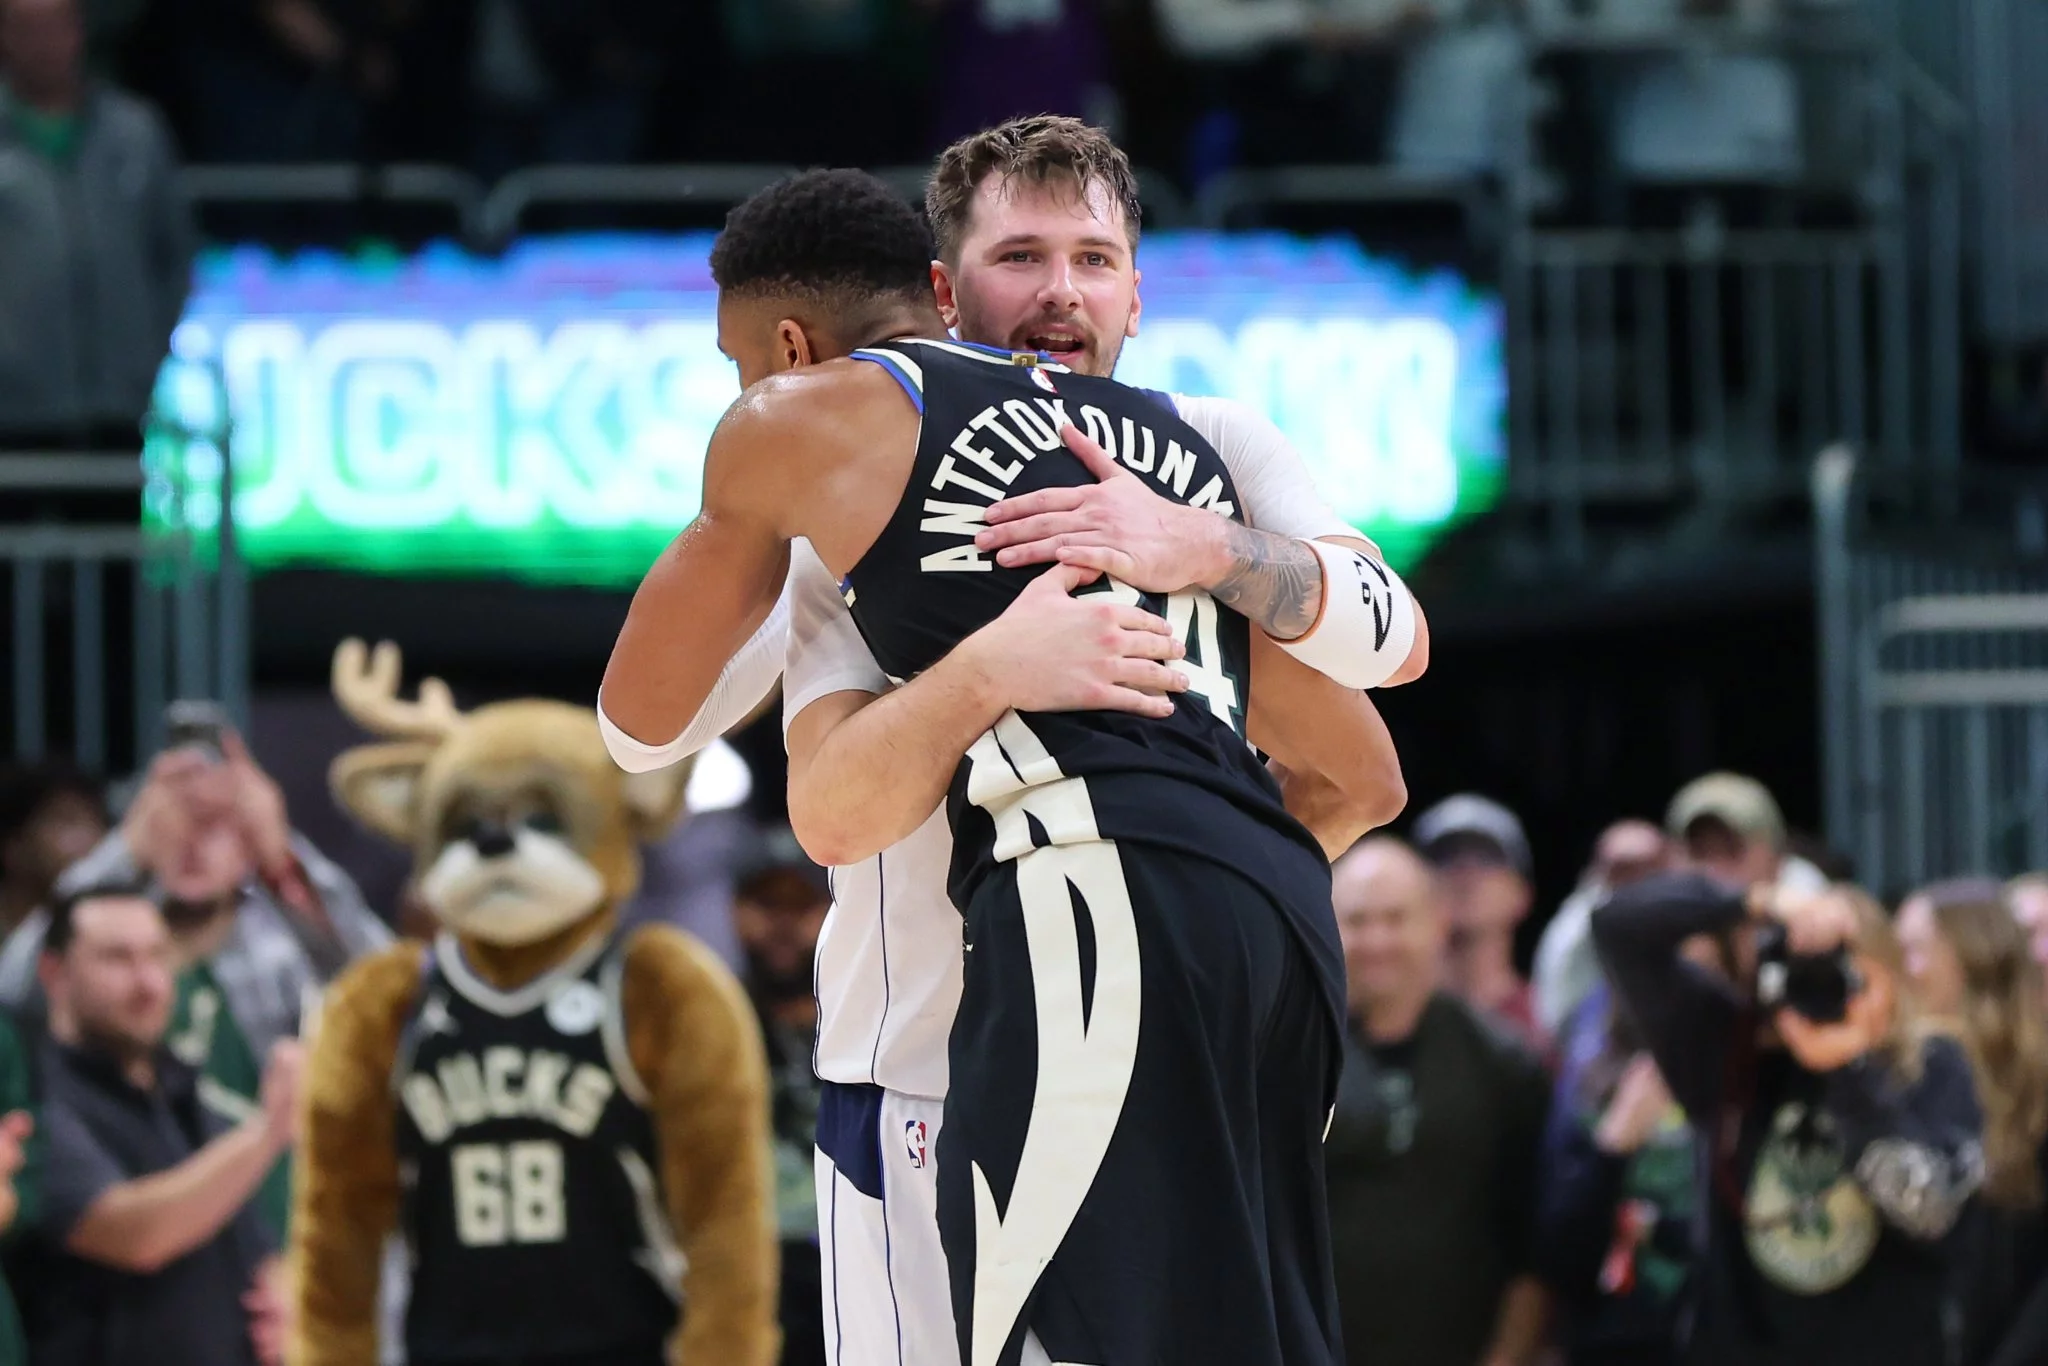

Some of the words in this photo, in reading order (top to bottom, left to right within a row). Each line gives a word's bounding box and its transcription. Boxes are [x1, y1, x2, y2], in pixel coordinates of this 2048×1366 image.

[1075, 572, 1238, 732] 4
[402, 1045, 614, 1144] BUCKS
[450, 1140, 567, 1247] 68
